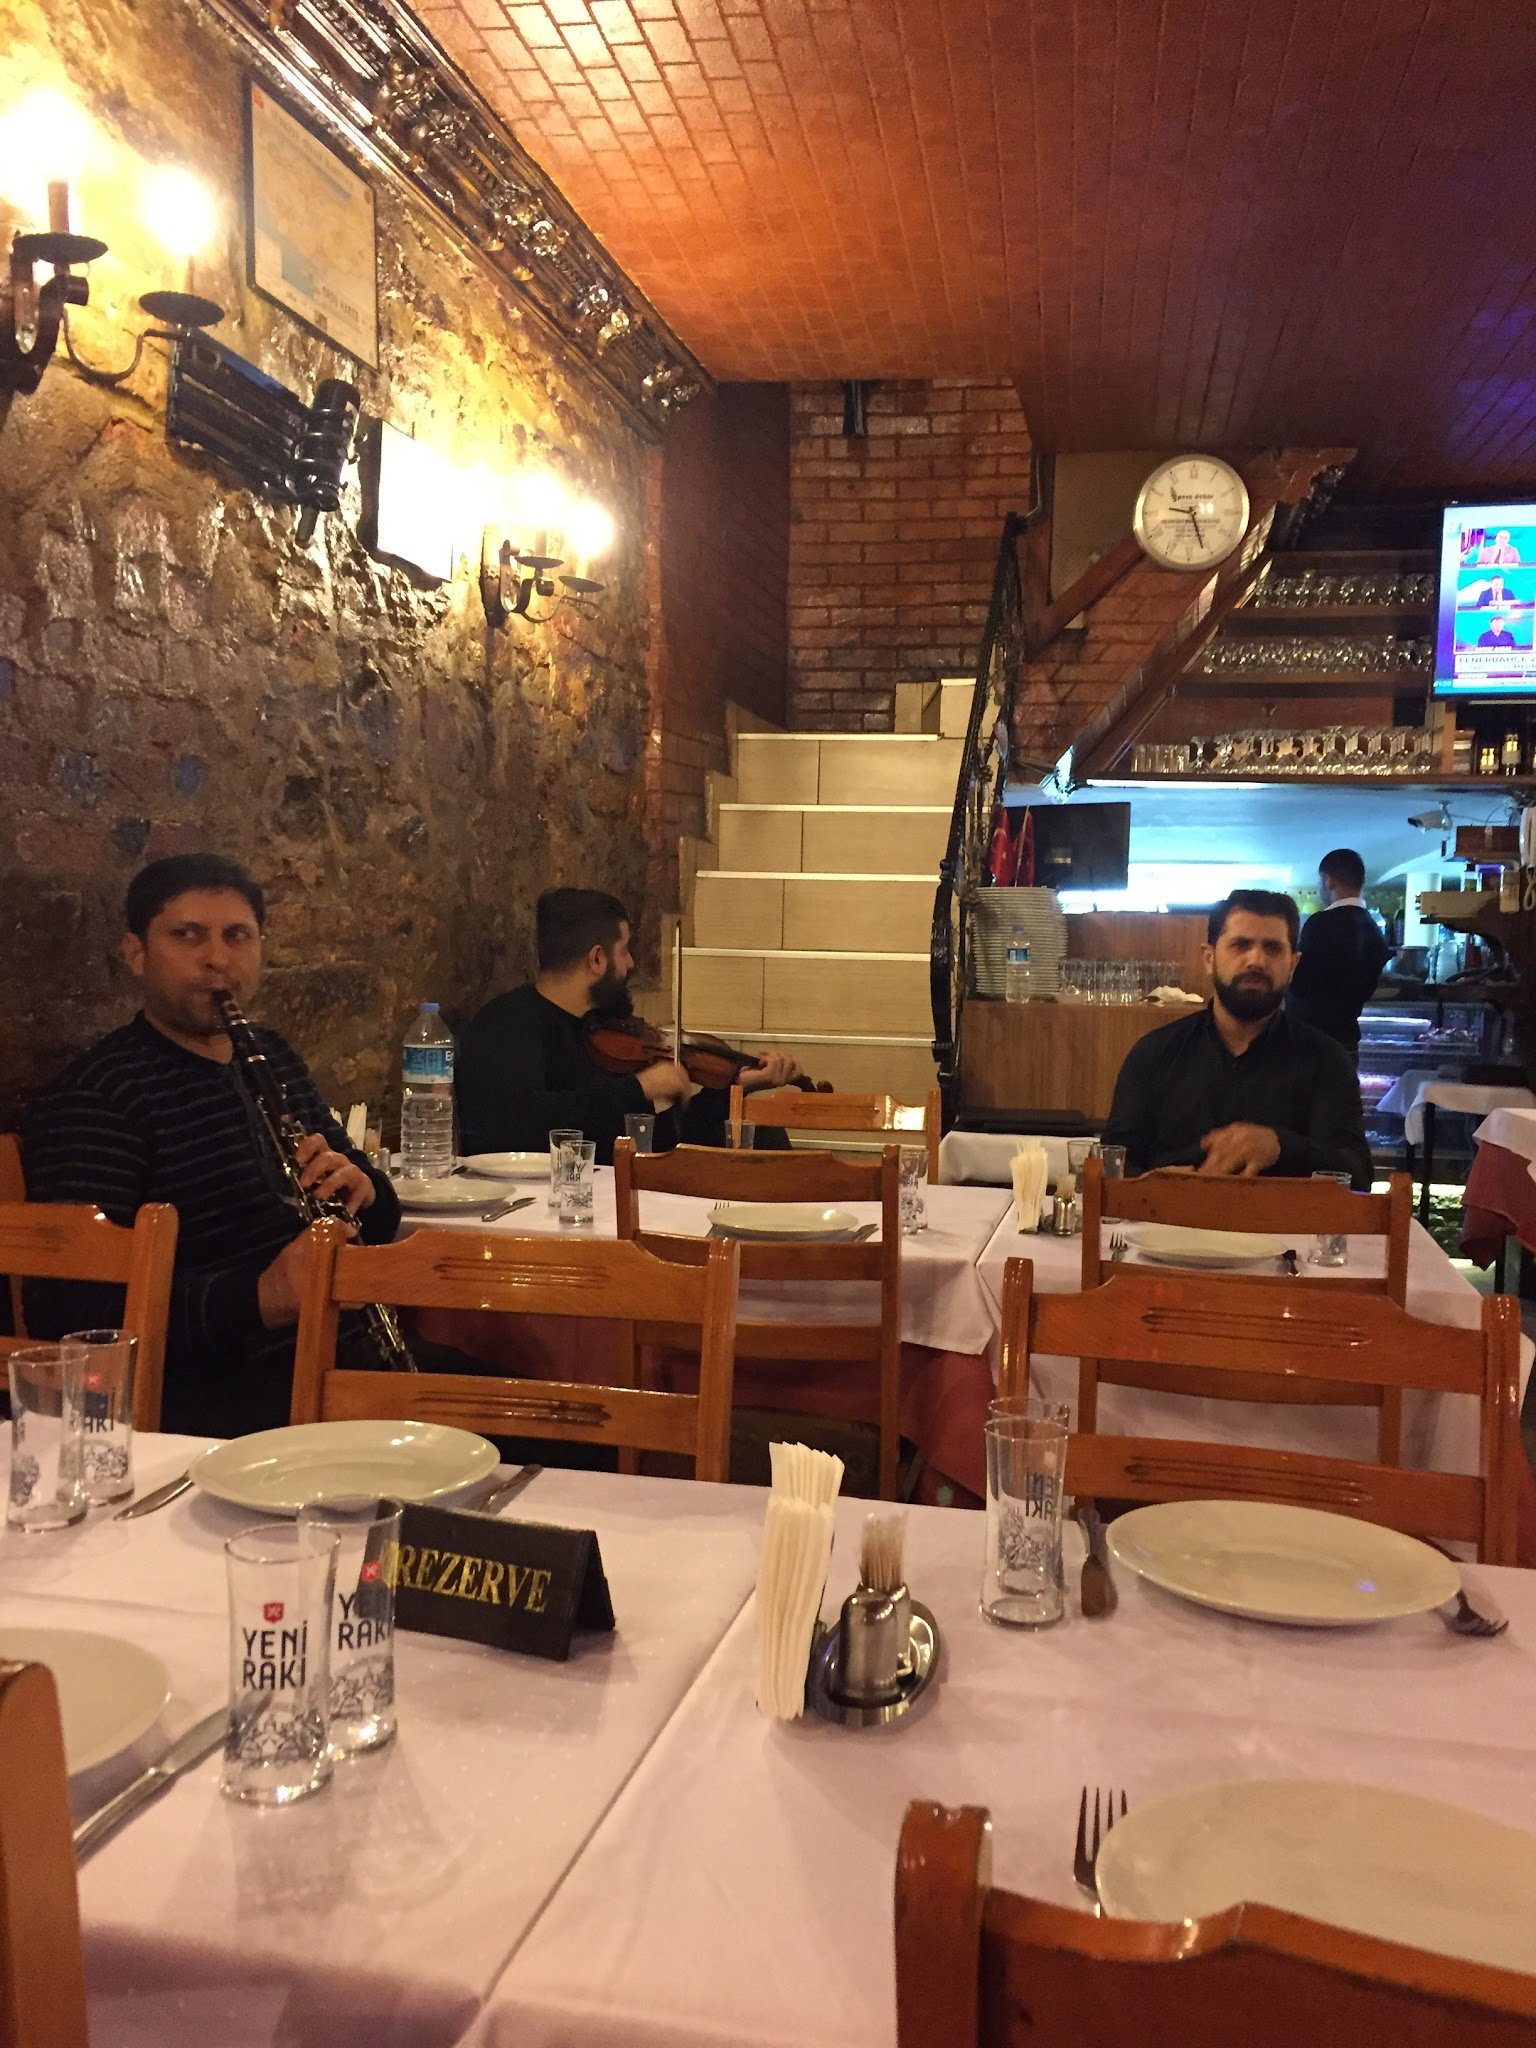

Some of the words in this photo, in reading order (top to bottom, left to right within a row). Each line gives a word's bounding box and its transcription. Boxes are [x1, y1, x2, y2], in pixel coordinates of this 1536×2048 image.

[384, 1540, 552, 1613] REZERVE
[242, 1619, 308, 1660] YENİ
[242, 1657, 307, 1691] RAKI
